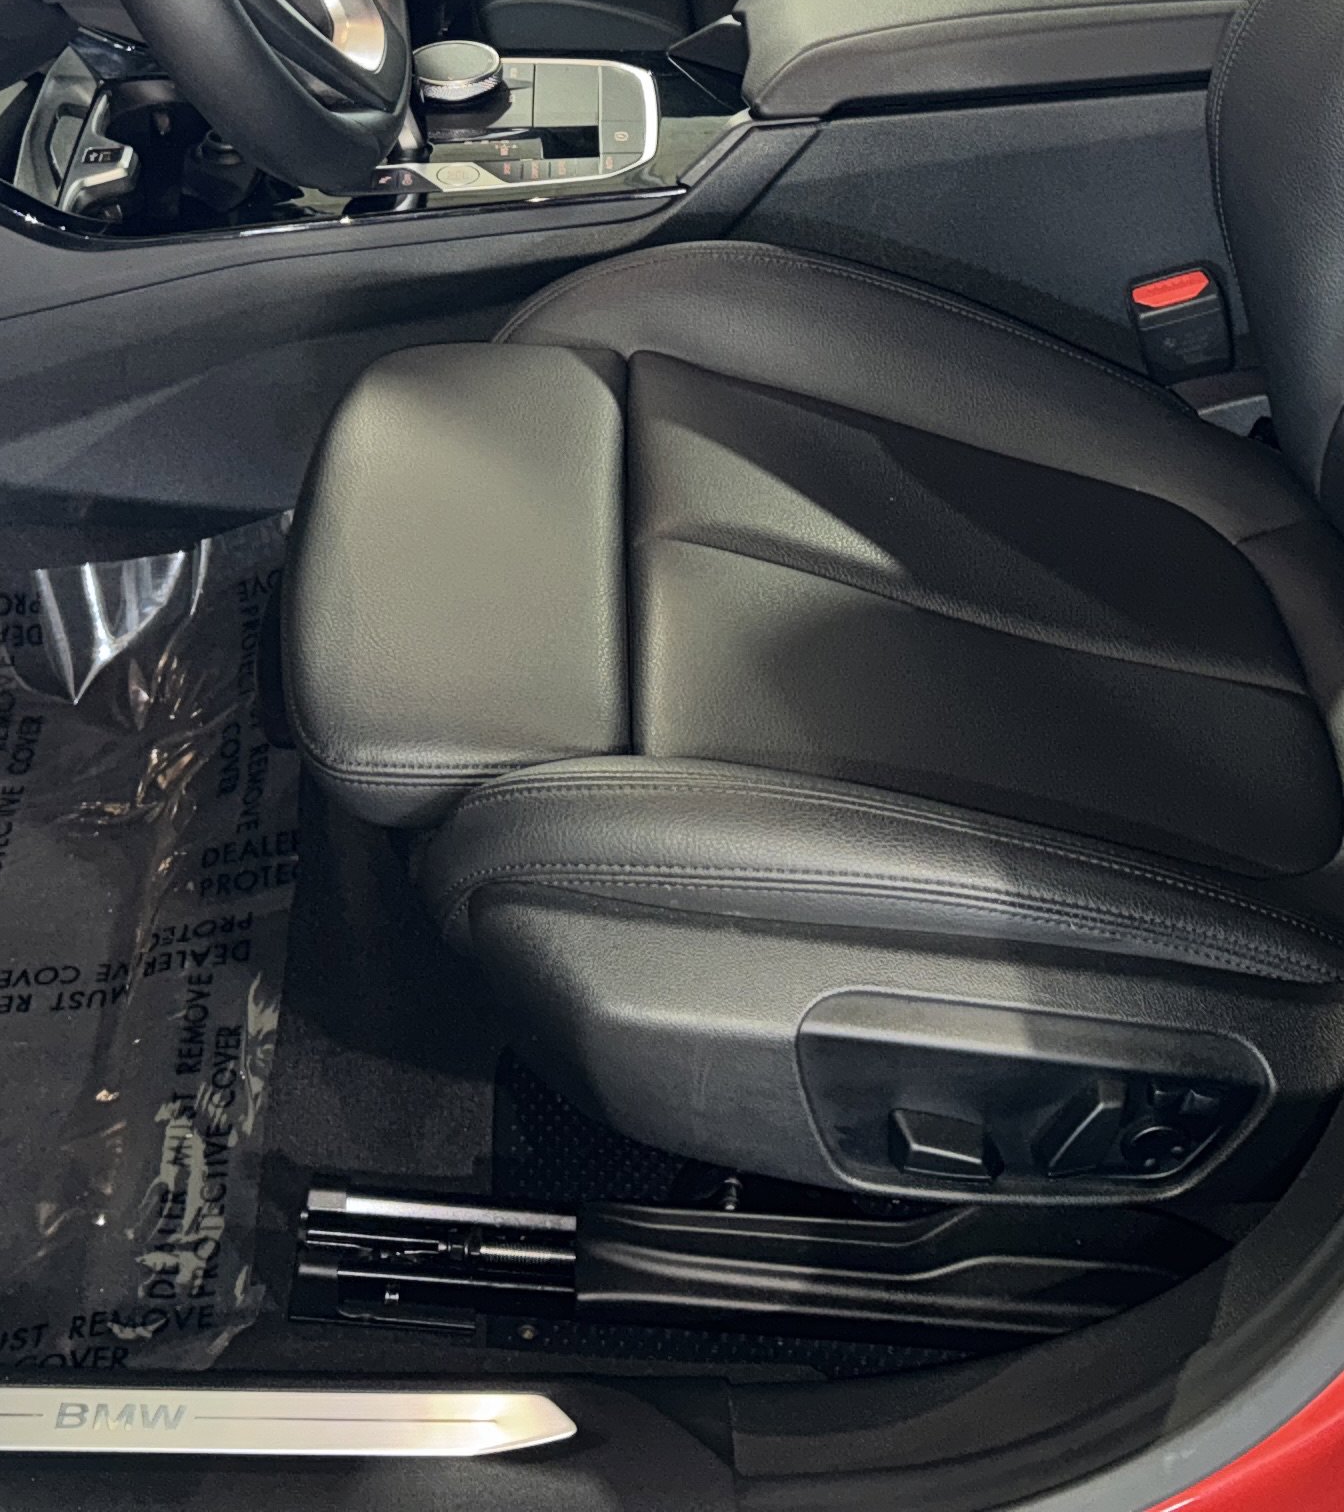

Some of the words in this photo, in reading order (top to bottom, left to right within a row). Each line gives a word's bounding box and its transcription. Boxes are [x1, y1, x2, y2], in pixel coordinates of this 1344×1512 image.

[8, 715, 47, 776] COVER
[142, 938, 252, 977] DEALER
[175, 971, 214, 1076] REMOVE
[209, 1023, 244, 1108] COVER
[54, 1401, 188, 1431] BMW
